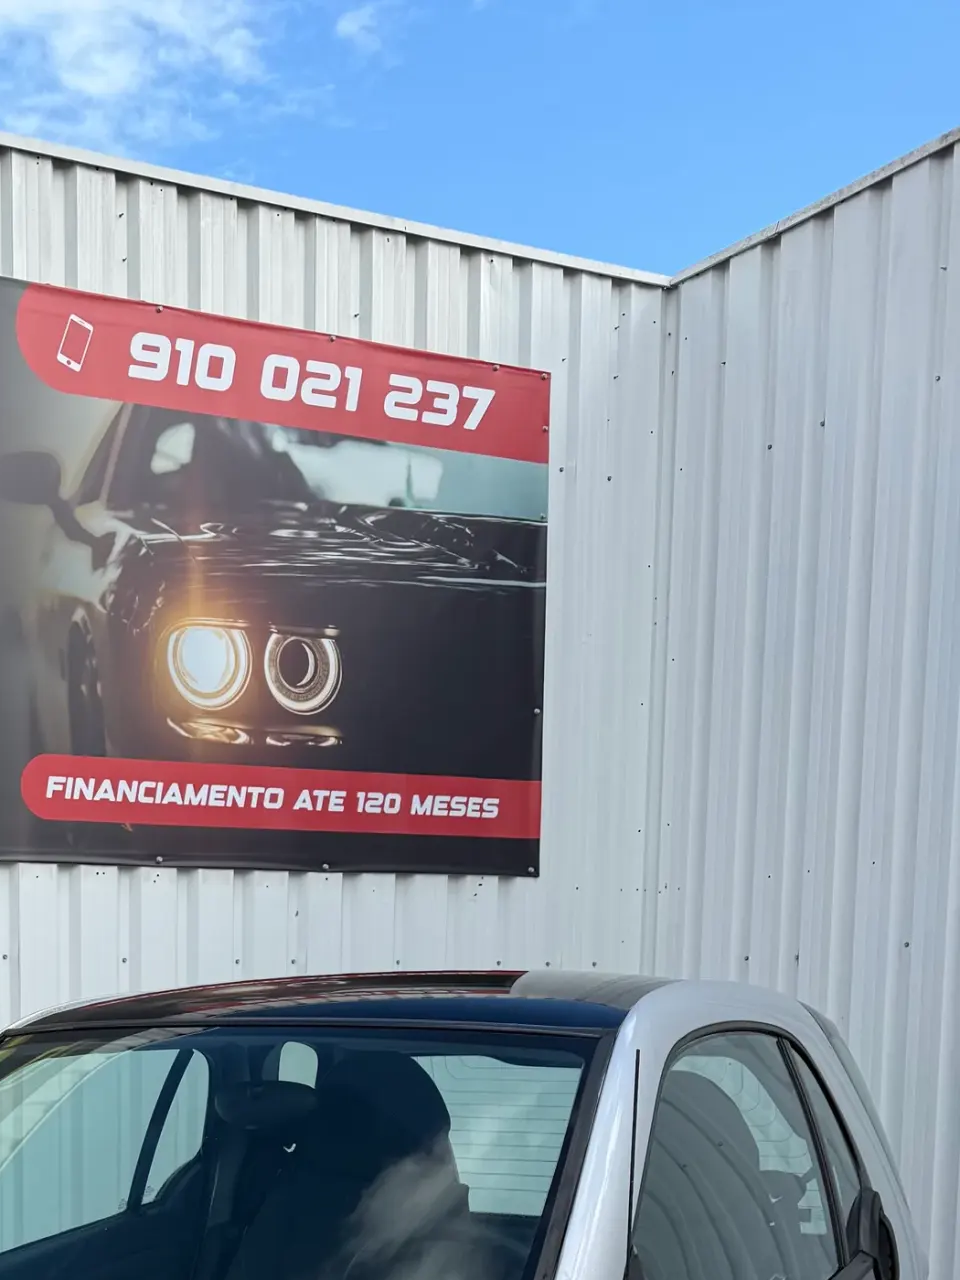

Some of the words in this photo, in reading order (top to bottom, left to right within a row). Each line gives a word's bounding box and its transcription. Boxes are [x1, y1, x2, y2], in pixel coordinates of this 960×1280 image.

[127, 331, 237, 392] 910
[259, 353, 363, 412] 021
[383, 373, 496, 431] 237
[45, 775, 285, 809] FINANCIAMENTO
[292, 789, 347, 812] ATE
[356, 791, 402, 814] 120
[410, 793, 500, 818] MESES
